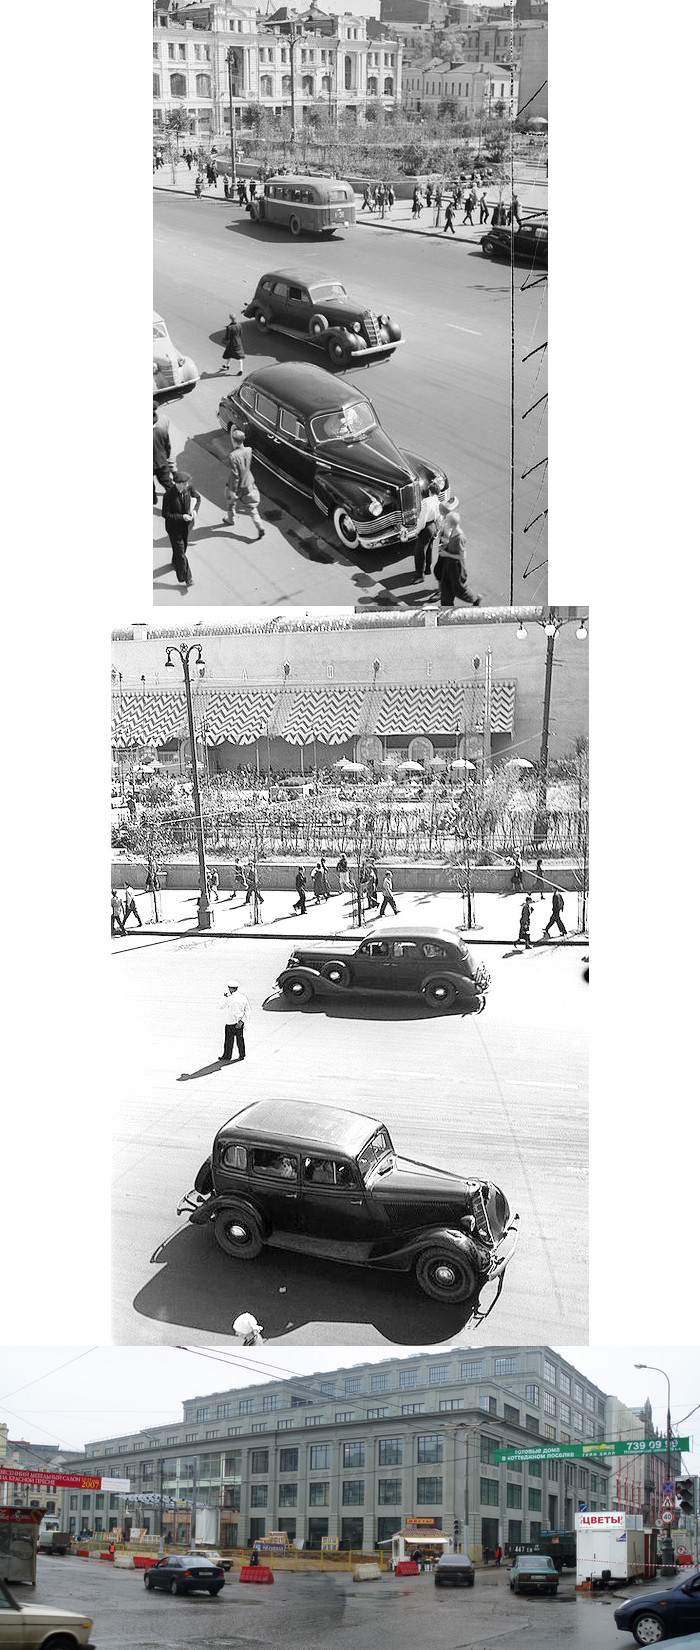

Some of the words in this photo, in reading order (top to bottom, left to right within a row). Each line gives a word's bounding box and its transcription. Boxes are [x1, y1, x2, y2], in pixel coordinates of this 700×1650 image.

[626, 1442, 646, 1451] 739
[649, 1440, 662, 1449] 09
[81, 1480, 100, 1489] 2007
[583, 1516, 621, 1525] ЦВЕТЫ
